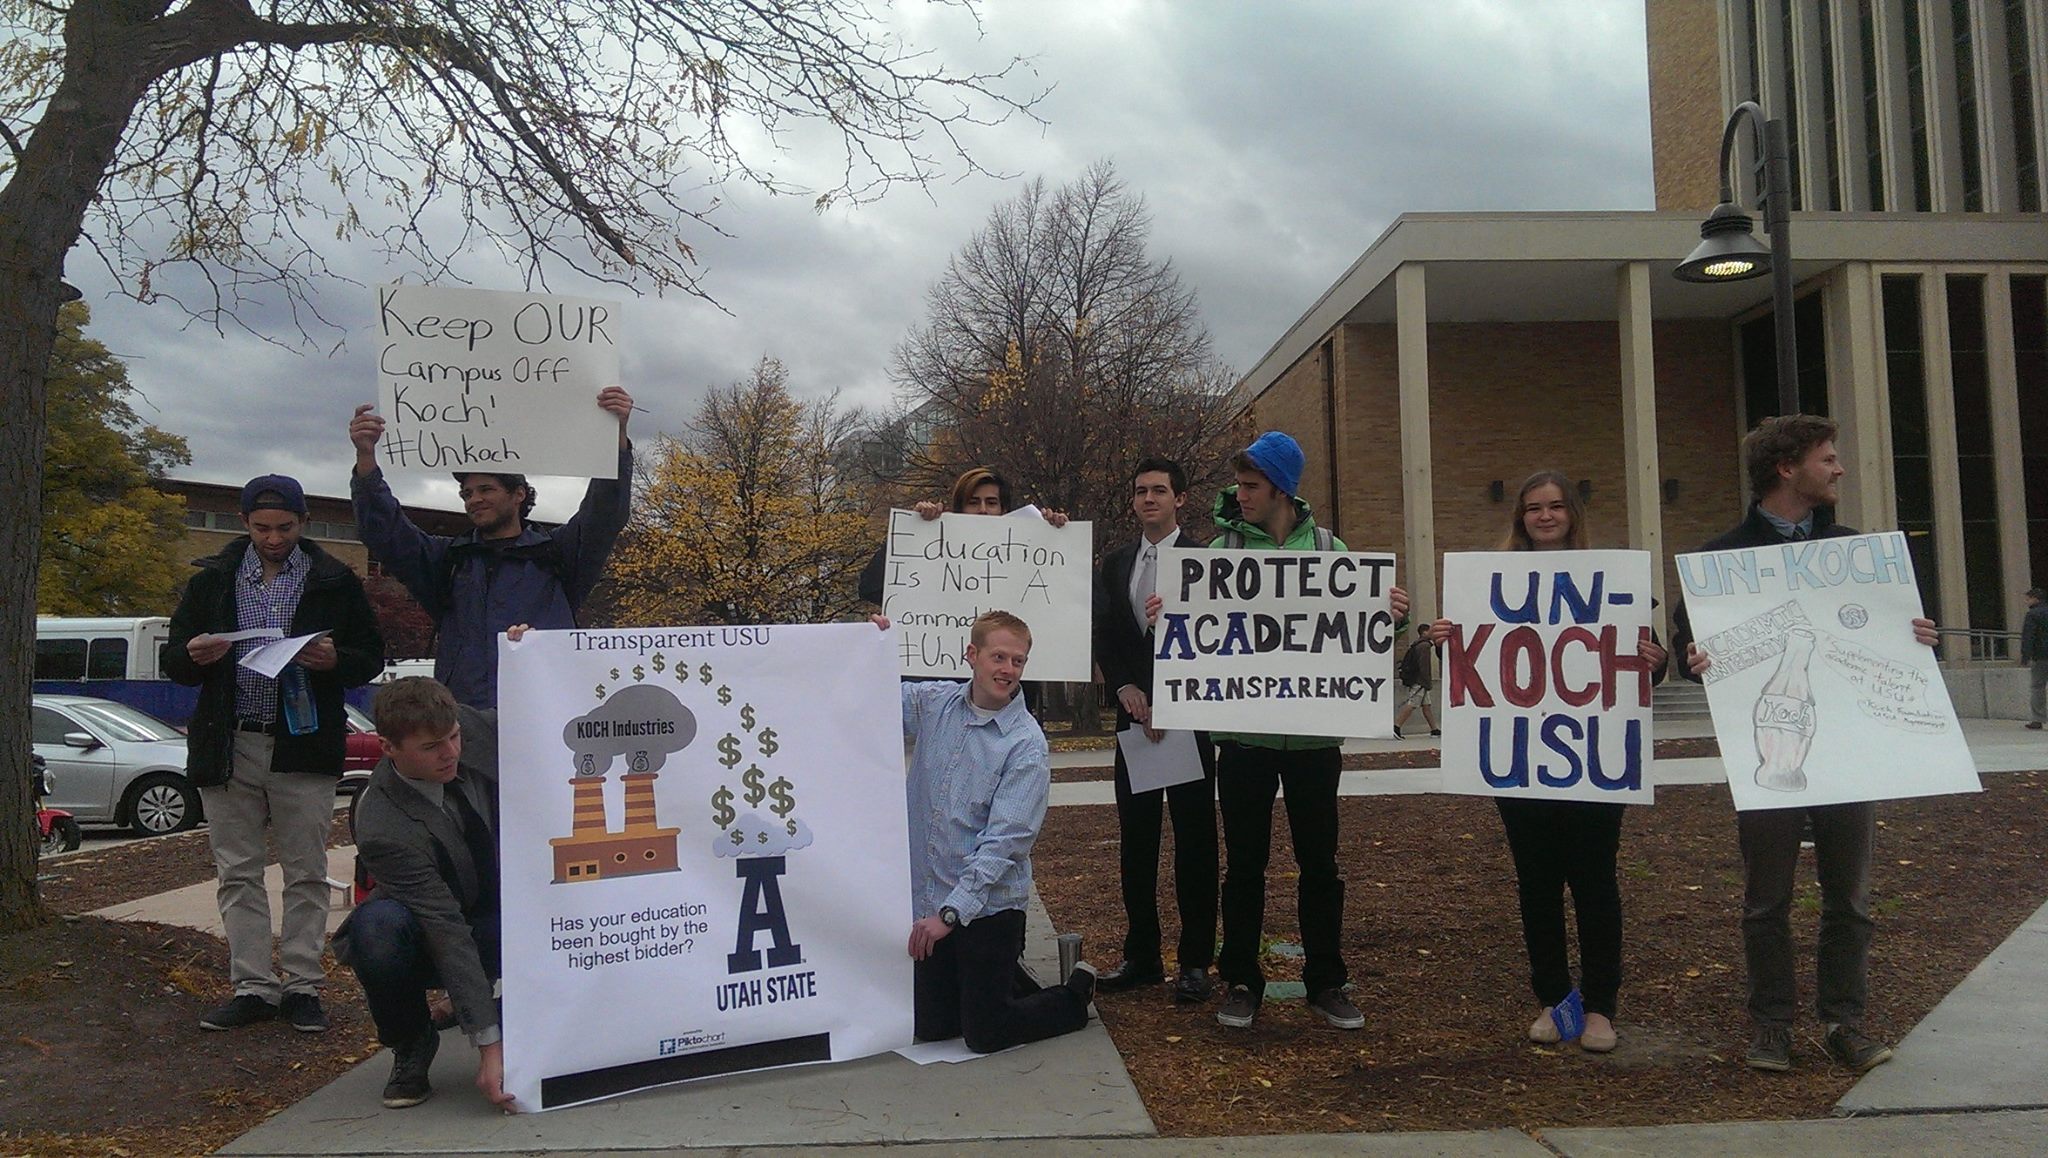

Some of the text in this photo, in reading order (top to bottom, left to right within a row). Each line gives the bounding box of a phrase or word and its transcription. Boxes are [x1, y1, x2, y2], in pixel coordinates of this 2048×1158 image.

[380, 288, 613, 351] Keep OUR
[380, 343, 502, 395] Campus
[382, 428, 520, 468] #Unkoch
[891, 511, 1065, 566] Education
[888, 561, 1051, 604] Is Not A
[1180, 556, 1394, 602] PROTECT
[1677, 534, 1910, 597] UN-KOCH
[1490, 571, 1634, 625] UN-
[569, 627, 771, 657] Transparent USU
[1155, 610, 1394, 660] ACADEMIC
[1165, 676, 1386, 702] TRANSPARENCY
[1450, 624, 1652, 711] KOCH
[577, 719, 675, 739] KOCH Industries
[1479, 714, 1642, 791] USU
[551, 902, 707, 932] Has your education
[551, 919, 708, 951] been bought by the
[568, 938, 694, 970] highest bidder?
[716, 971, 817, 1012] UTAH STATE
